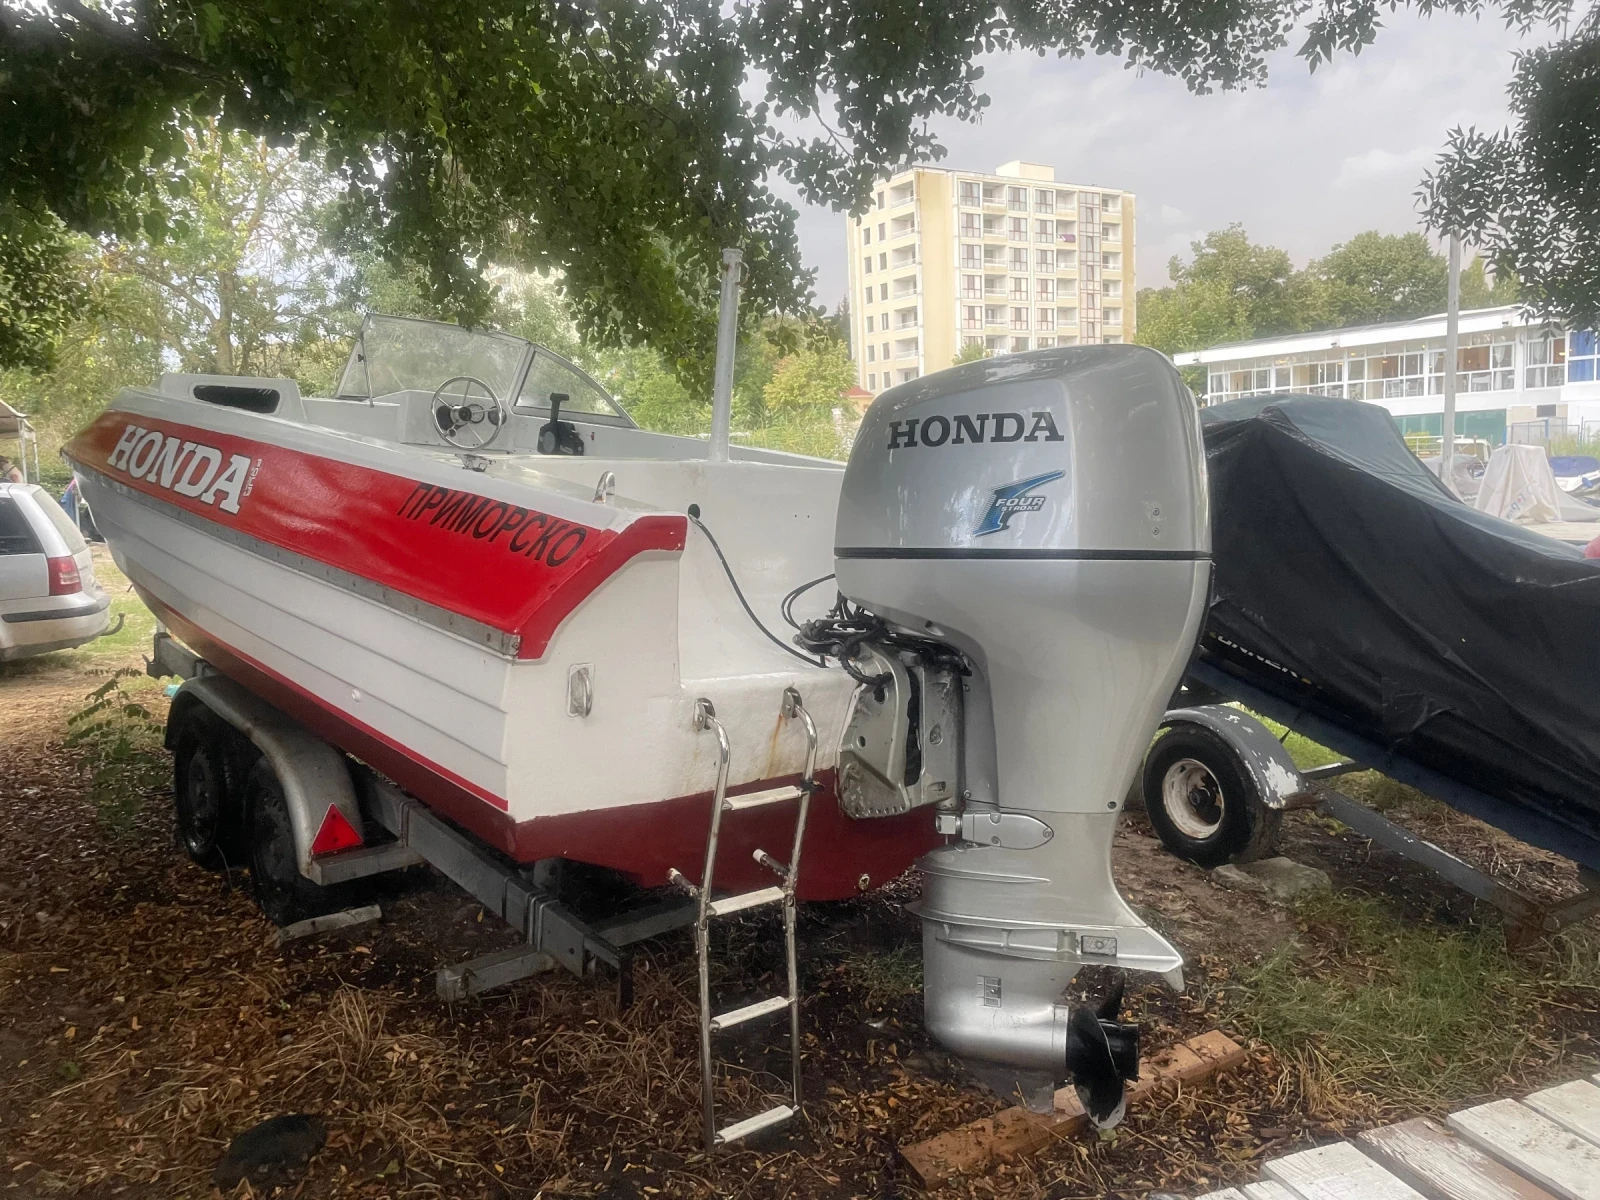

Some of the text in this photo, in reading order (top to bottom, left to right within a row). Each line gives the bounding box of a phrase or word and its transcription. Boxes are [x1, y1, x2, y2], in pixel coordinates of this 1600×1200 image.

[887, 411, 1065, 450] HONDA
[106, 424, 251, 515] HONDA
[397, 482, 587, 568] ПРИМОРСКО
[995, 497, 1045, 507] FOUR
